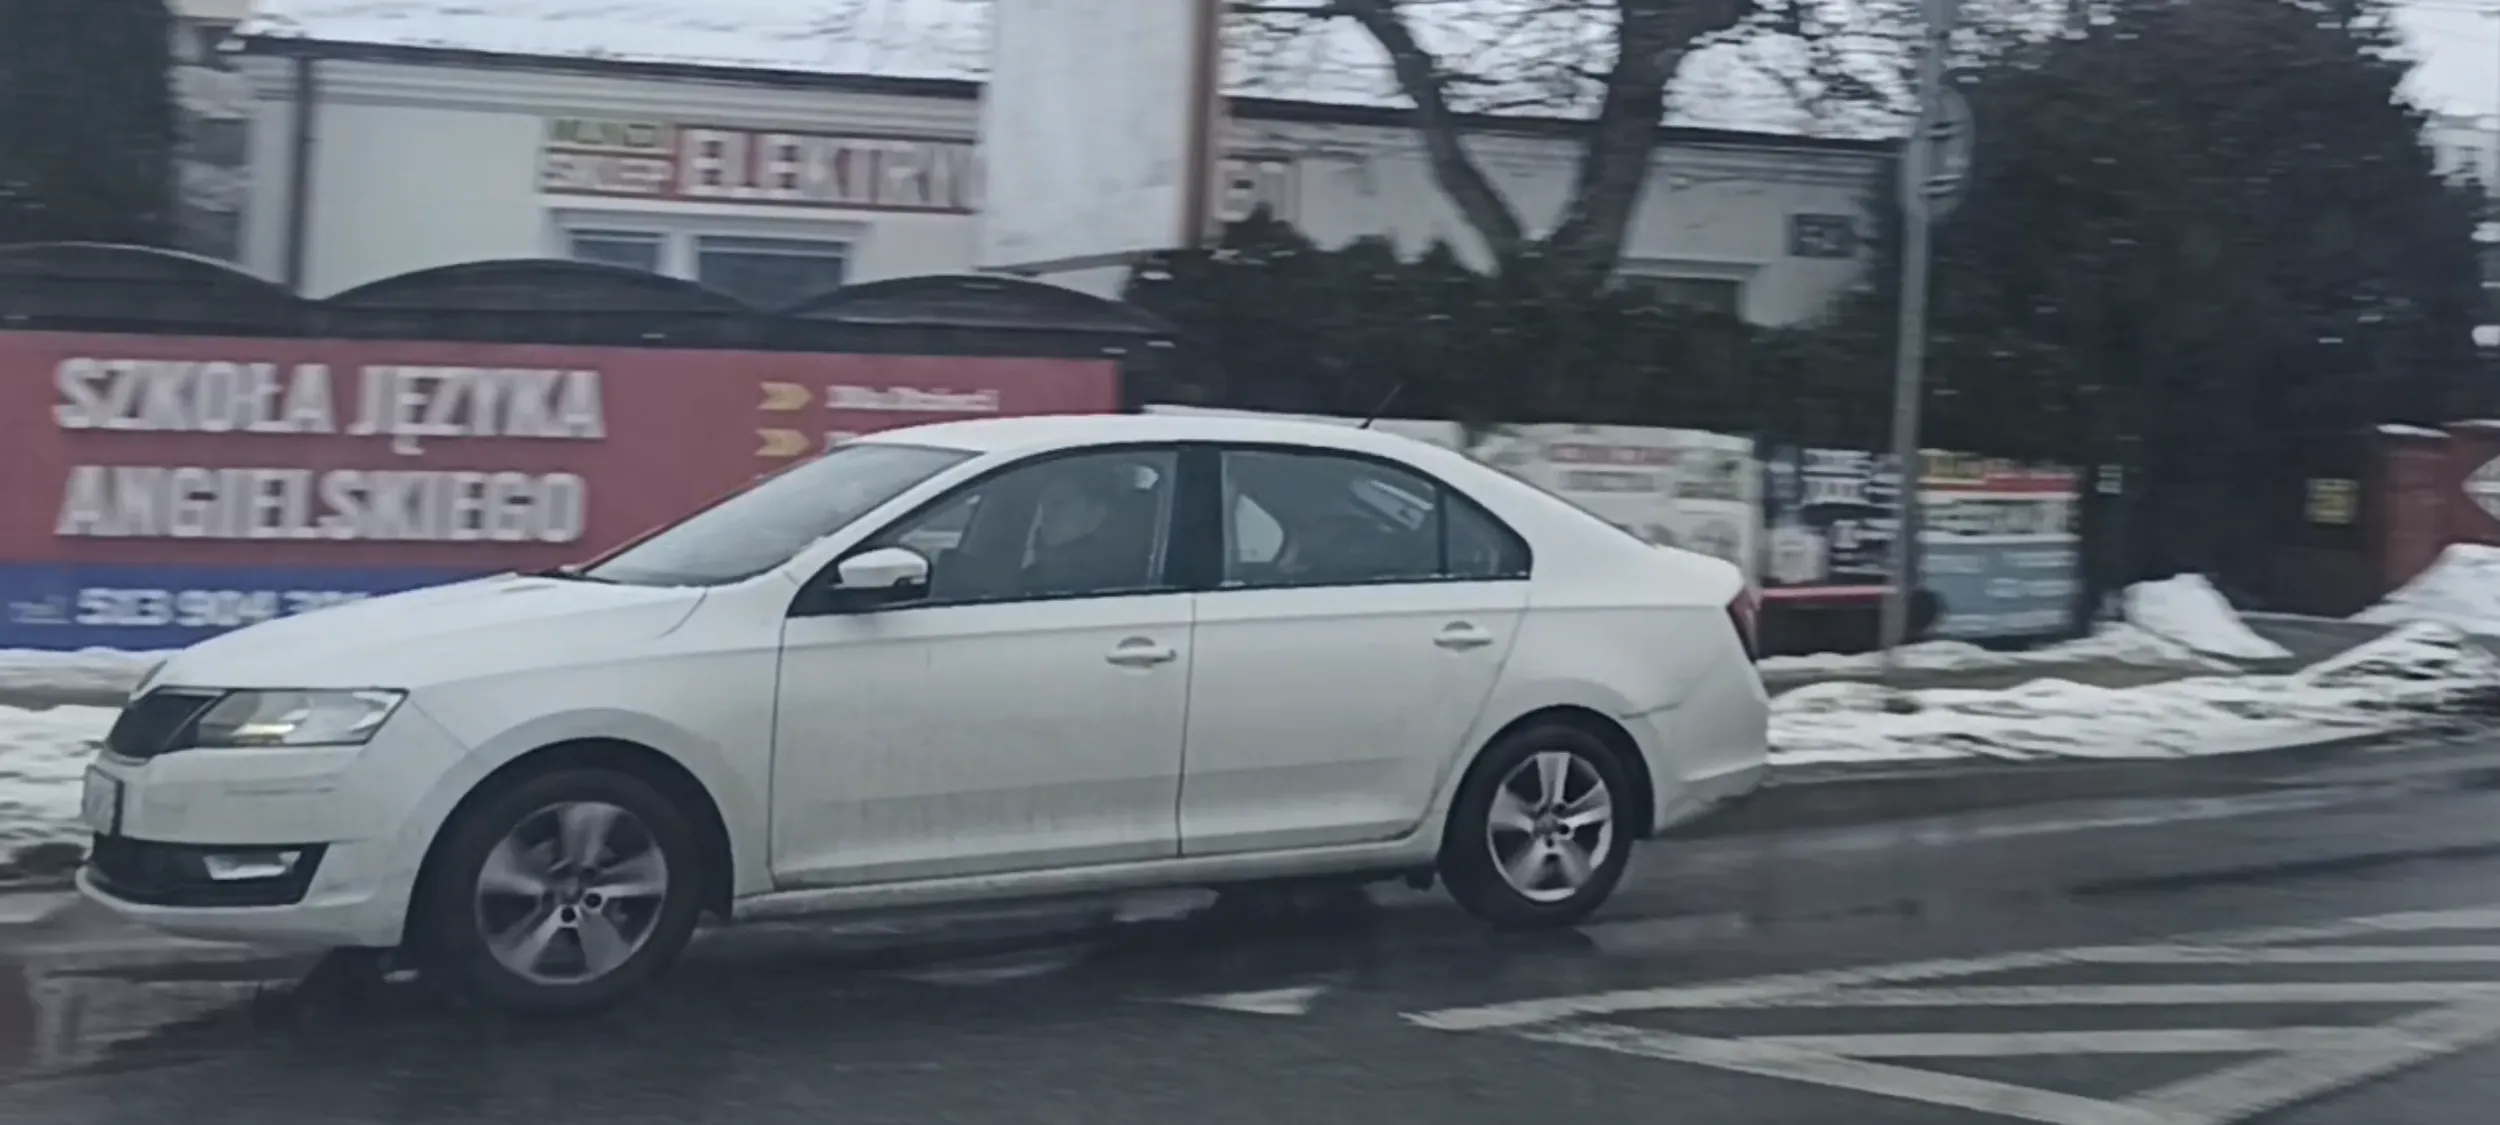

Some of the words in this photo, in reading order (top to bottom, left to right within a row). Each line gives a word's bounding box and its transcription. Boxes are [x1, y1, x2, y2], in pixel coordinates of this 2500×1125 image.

[53, 358, 337, 433] SZKOŁA
[347, 365, 606, 455] JĘZYKA
[55, 465, 587, 542] ANGIELSKIEGO
